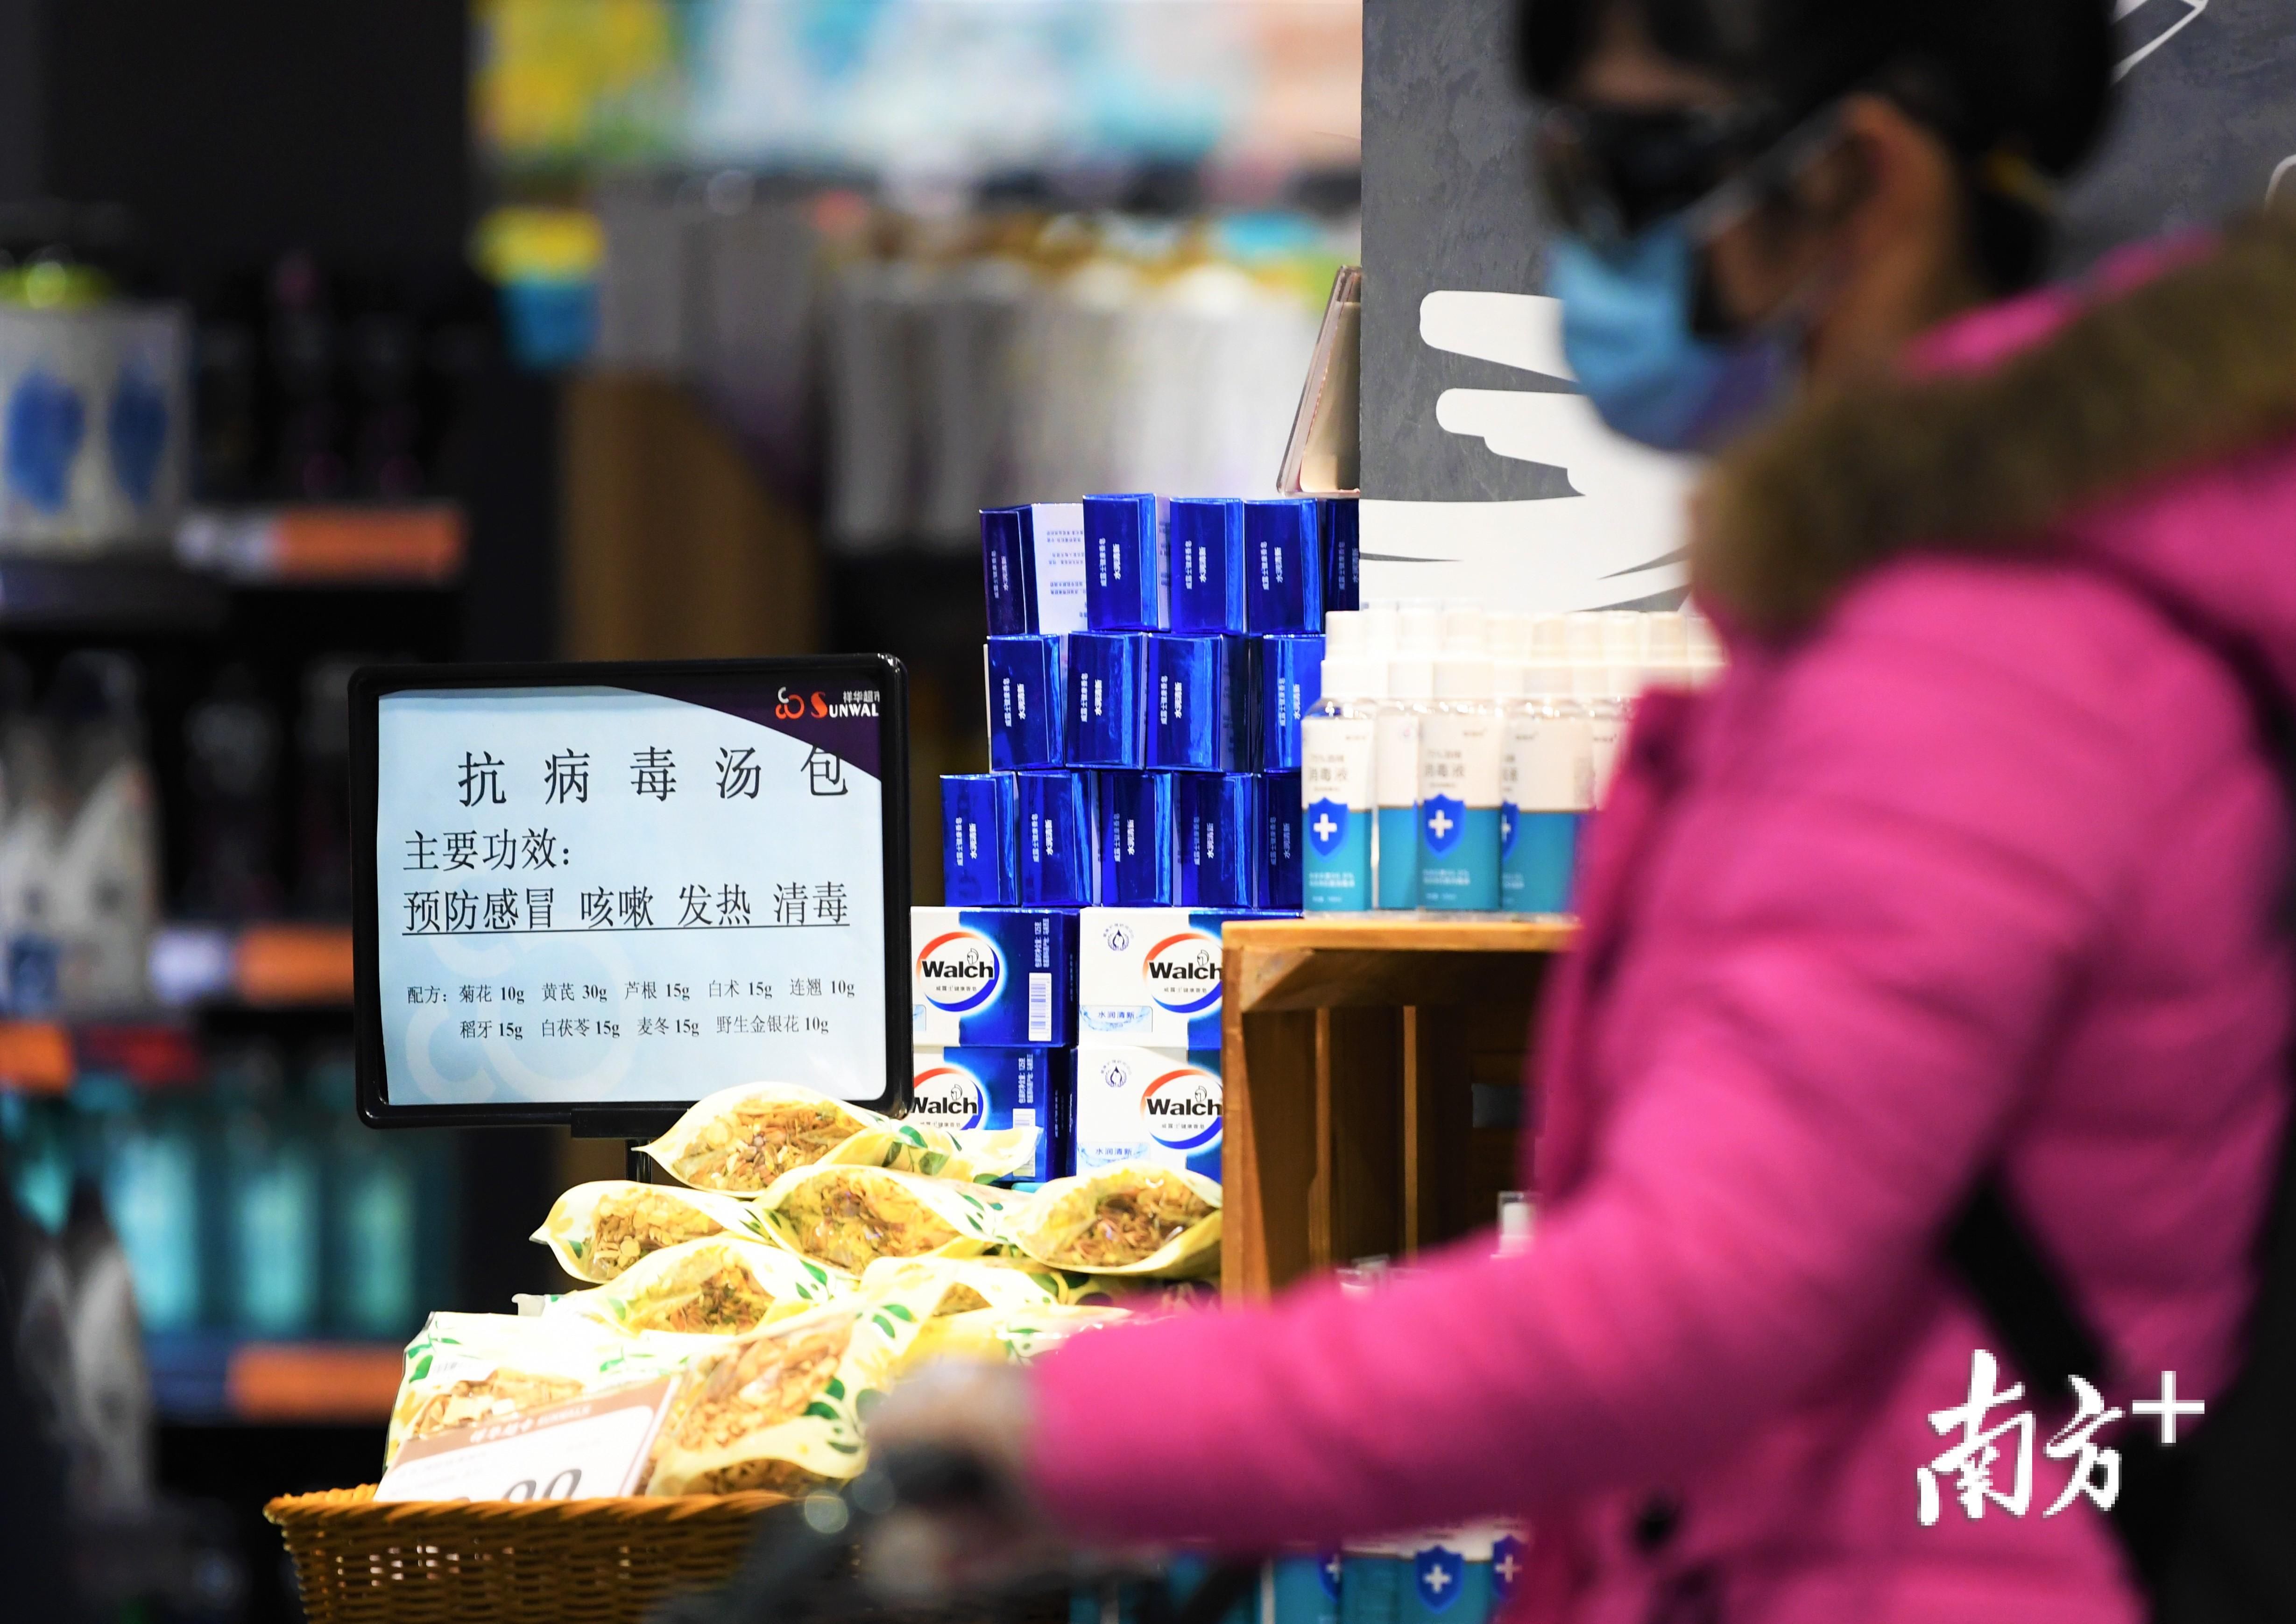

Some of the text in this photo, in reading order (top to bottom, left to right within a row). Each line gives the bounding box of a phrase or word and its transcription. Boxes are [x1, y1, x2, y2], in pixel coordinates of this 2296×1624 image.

[404, 881, 848, 933] 预防感冒 咳嗽 发热 清毒
[921, 960, 994, 979] Walch
[1149, 962, 1222, 980] Walch
[459, 984, 492, 1003] 菊花
[501, 986, 524, 1004] 10g
[542, 982, 575, 1002] 黄芪
[582, 984, 607, 1002] 30g
[624, 980, 657, 999] 芦根
[666, 983, 690, 1001] 15g
[709, 979, 740, 998] 白术
[749, 981, 772, 998] 15g
[790, 978, 822, 996] 连翘
[832, 980, 855, 997] 10g
[459, 1015, 829, 1040] 稻牙 15g 白茯苓 15g 麦冬 15g 野生金银花 10g
[912, 1097, 977, 1115] Walch
[1147, 1099, 1222, 1116] Walch
